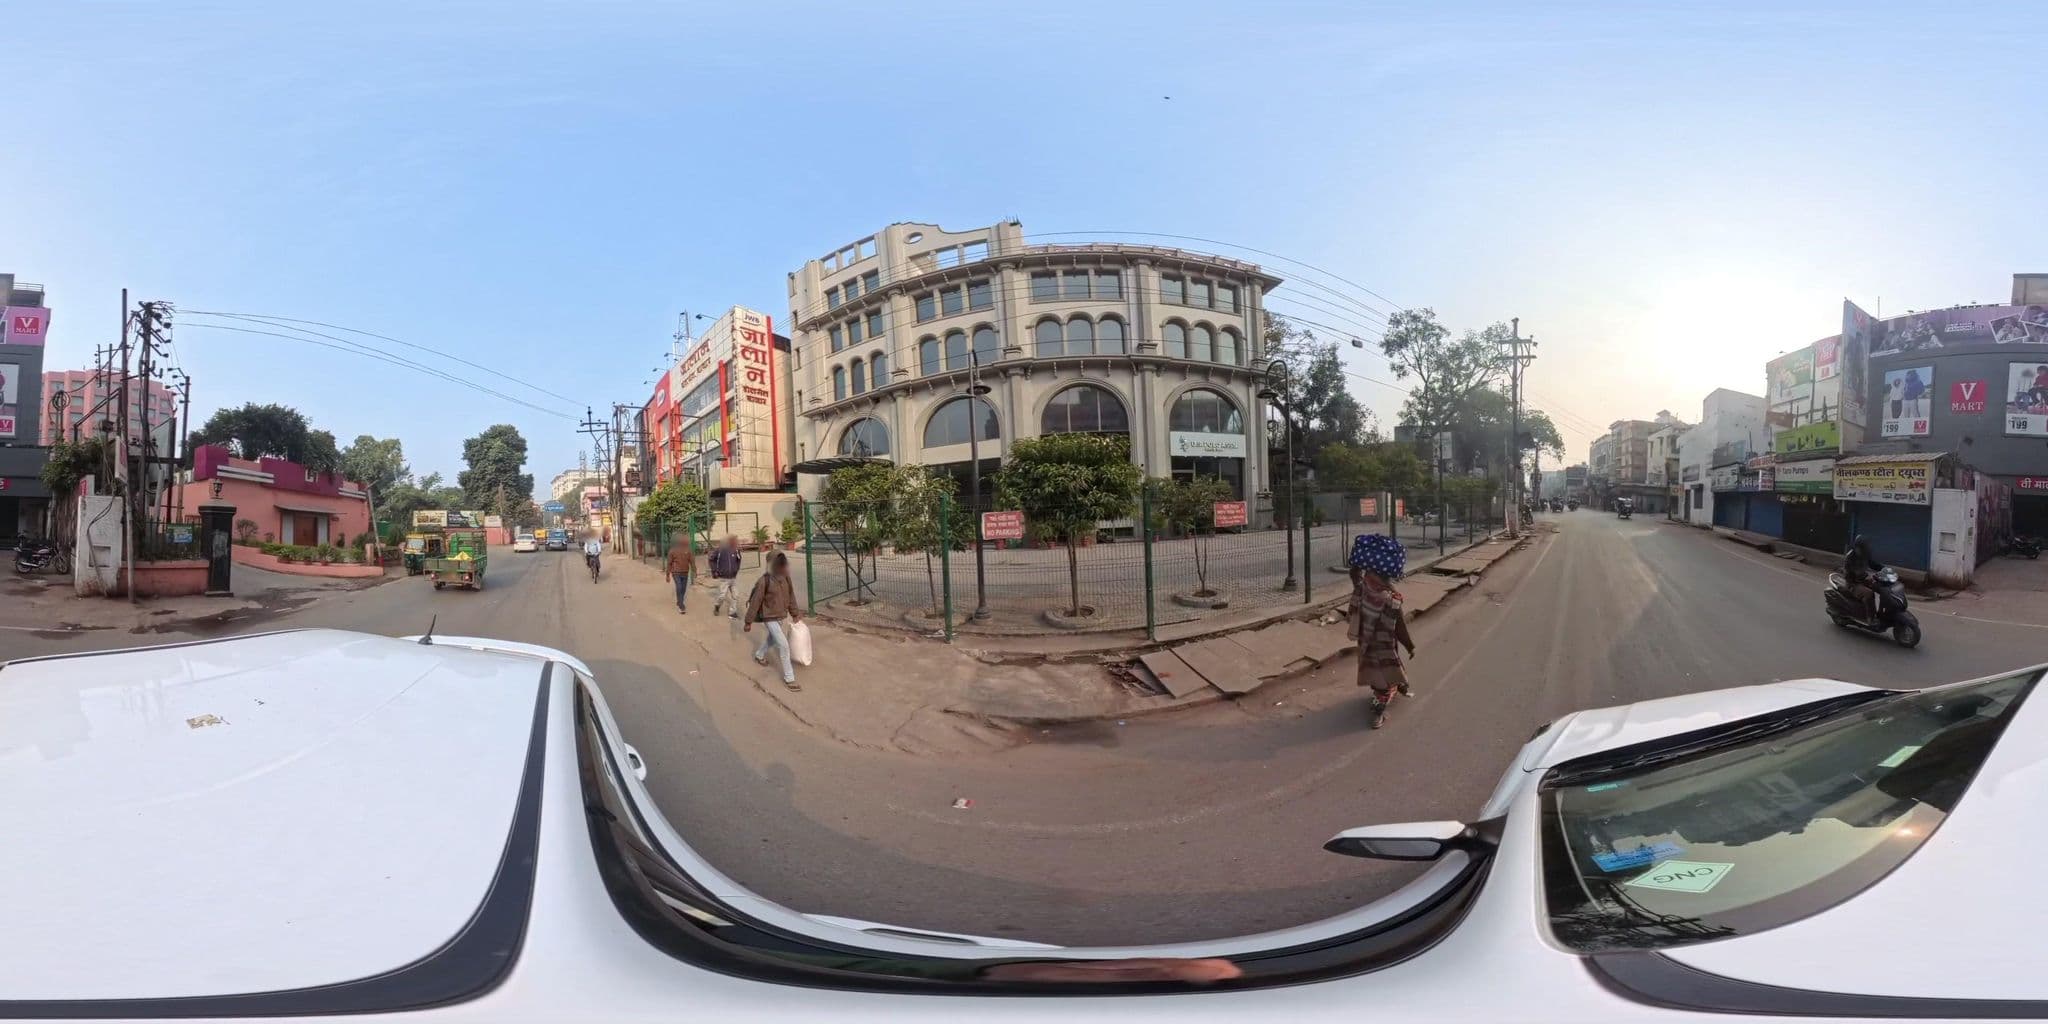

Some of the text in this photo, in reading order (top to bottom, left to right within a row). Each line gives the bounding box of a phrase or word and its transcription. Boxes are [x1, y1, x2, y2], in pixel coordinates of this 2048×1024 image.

[20, 317, 34, 328] V
[1960, 382, 1977, 400] V
[1951, 401, 1984, 411] MART
[2020, 477, 2032, 489] वी
[995, 529, 1021, 537] PARKING
[1653, 867, 1713, 883] CNG
